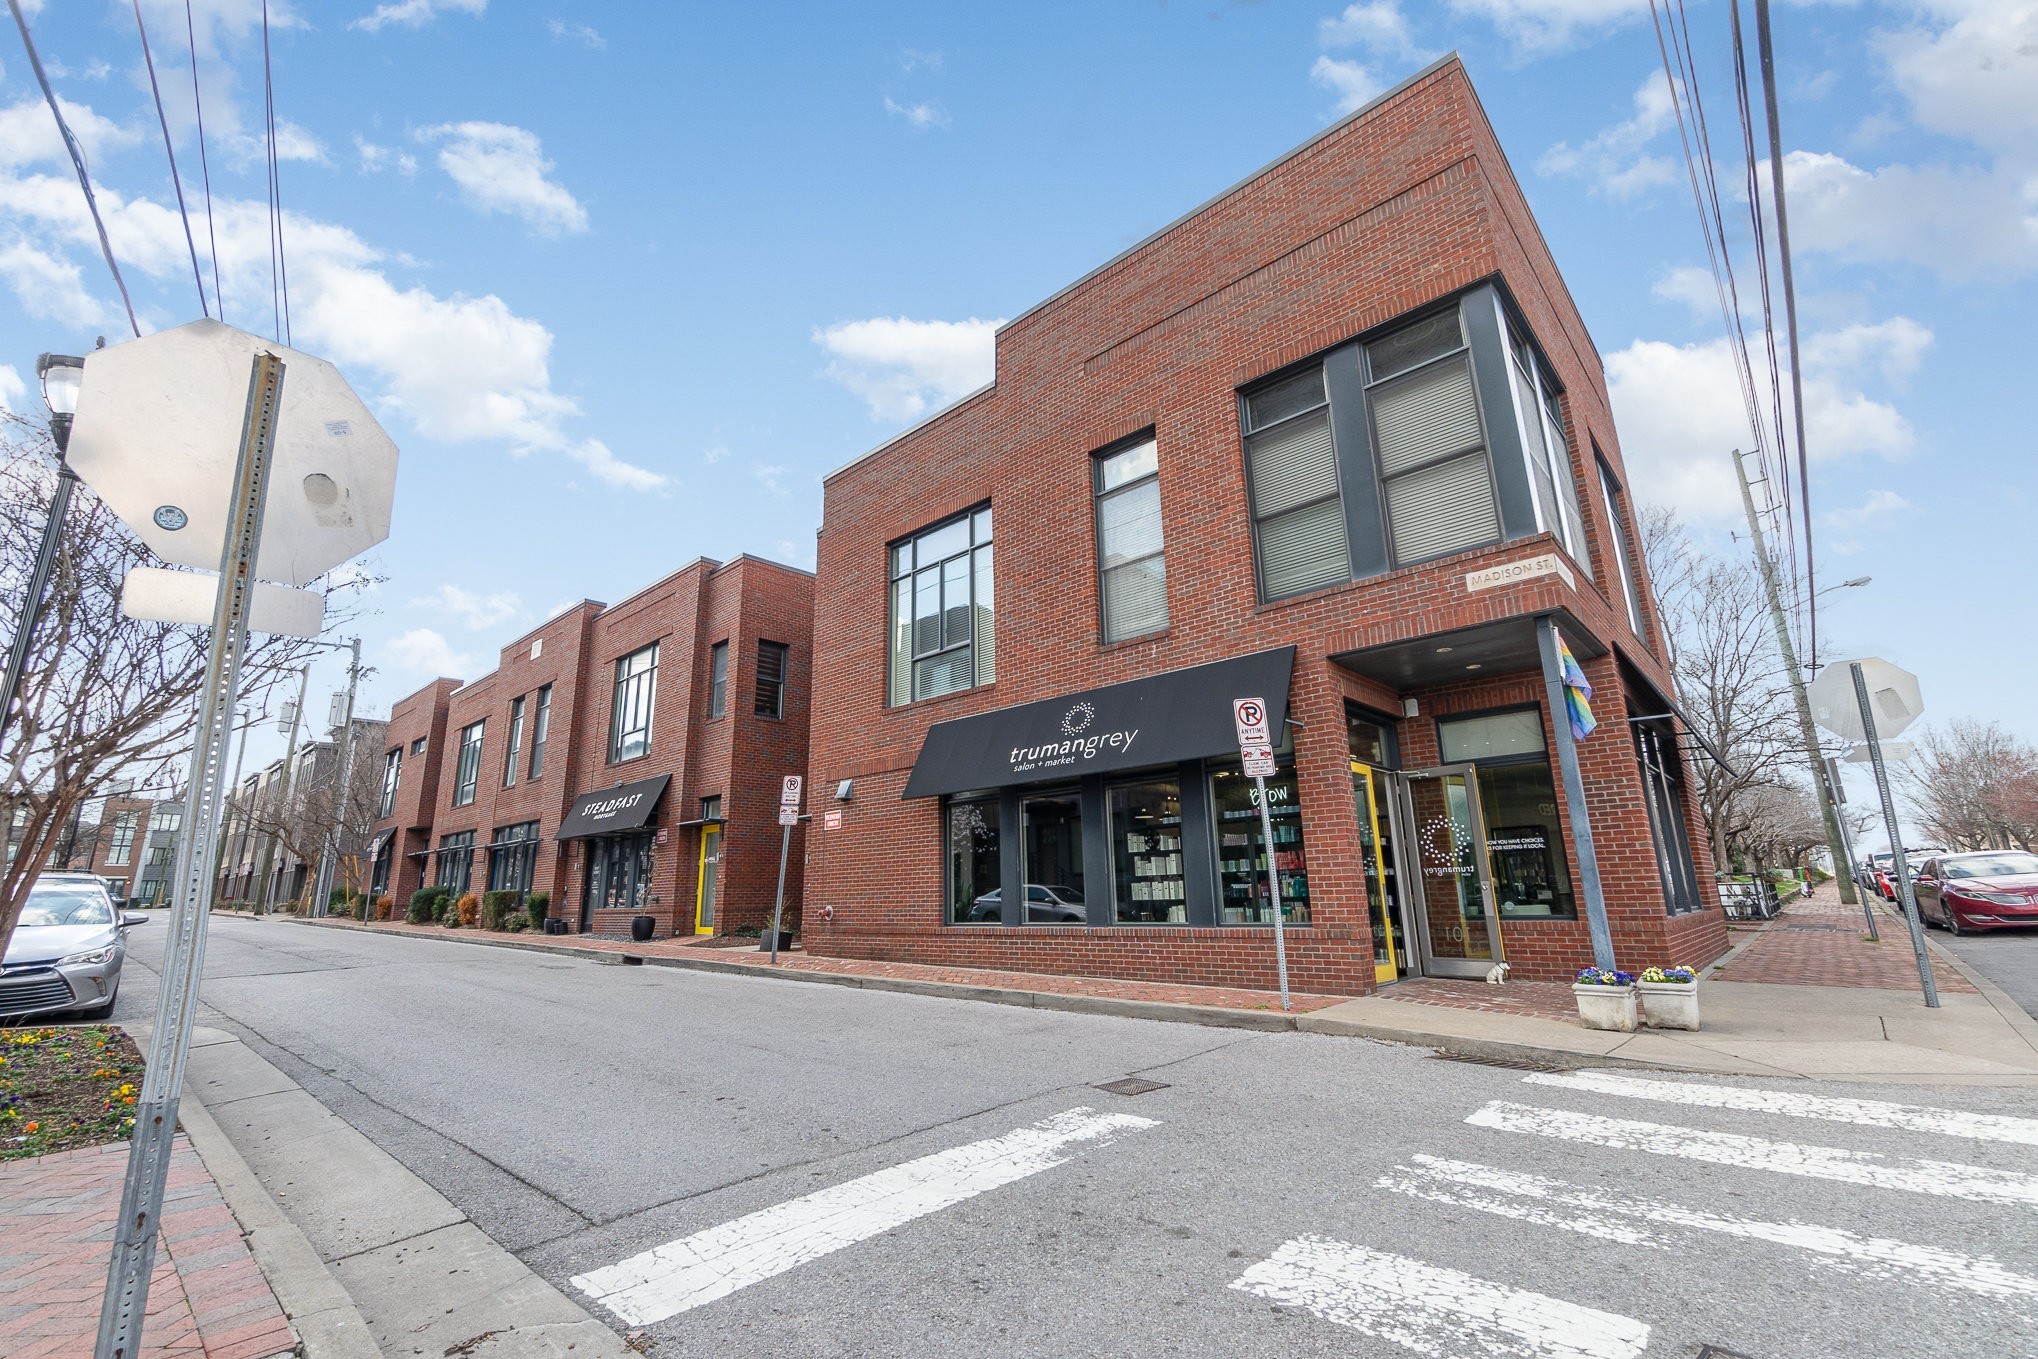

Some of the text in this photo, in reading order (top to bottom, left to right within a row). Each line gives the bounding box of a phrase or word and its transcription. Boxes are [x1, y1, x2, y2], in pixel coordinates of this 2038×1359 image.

[1471, 559, 1553, 586] MADISON ST.
[1241, 726, 1265, 734] ANYTIME
[1009, 729, 1139, 763] trumangrey
[1013, 762, 1035, 772] salon
[1044, 755, 1075, 767] market
[581, 793, 643, 816] STEADFAST
